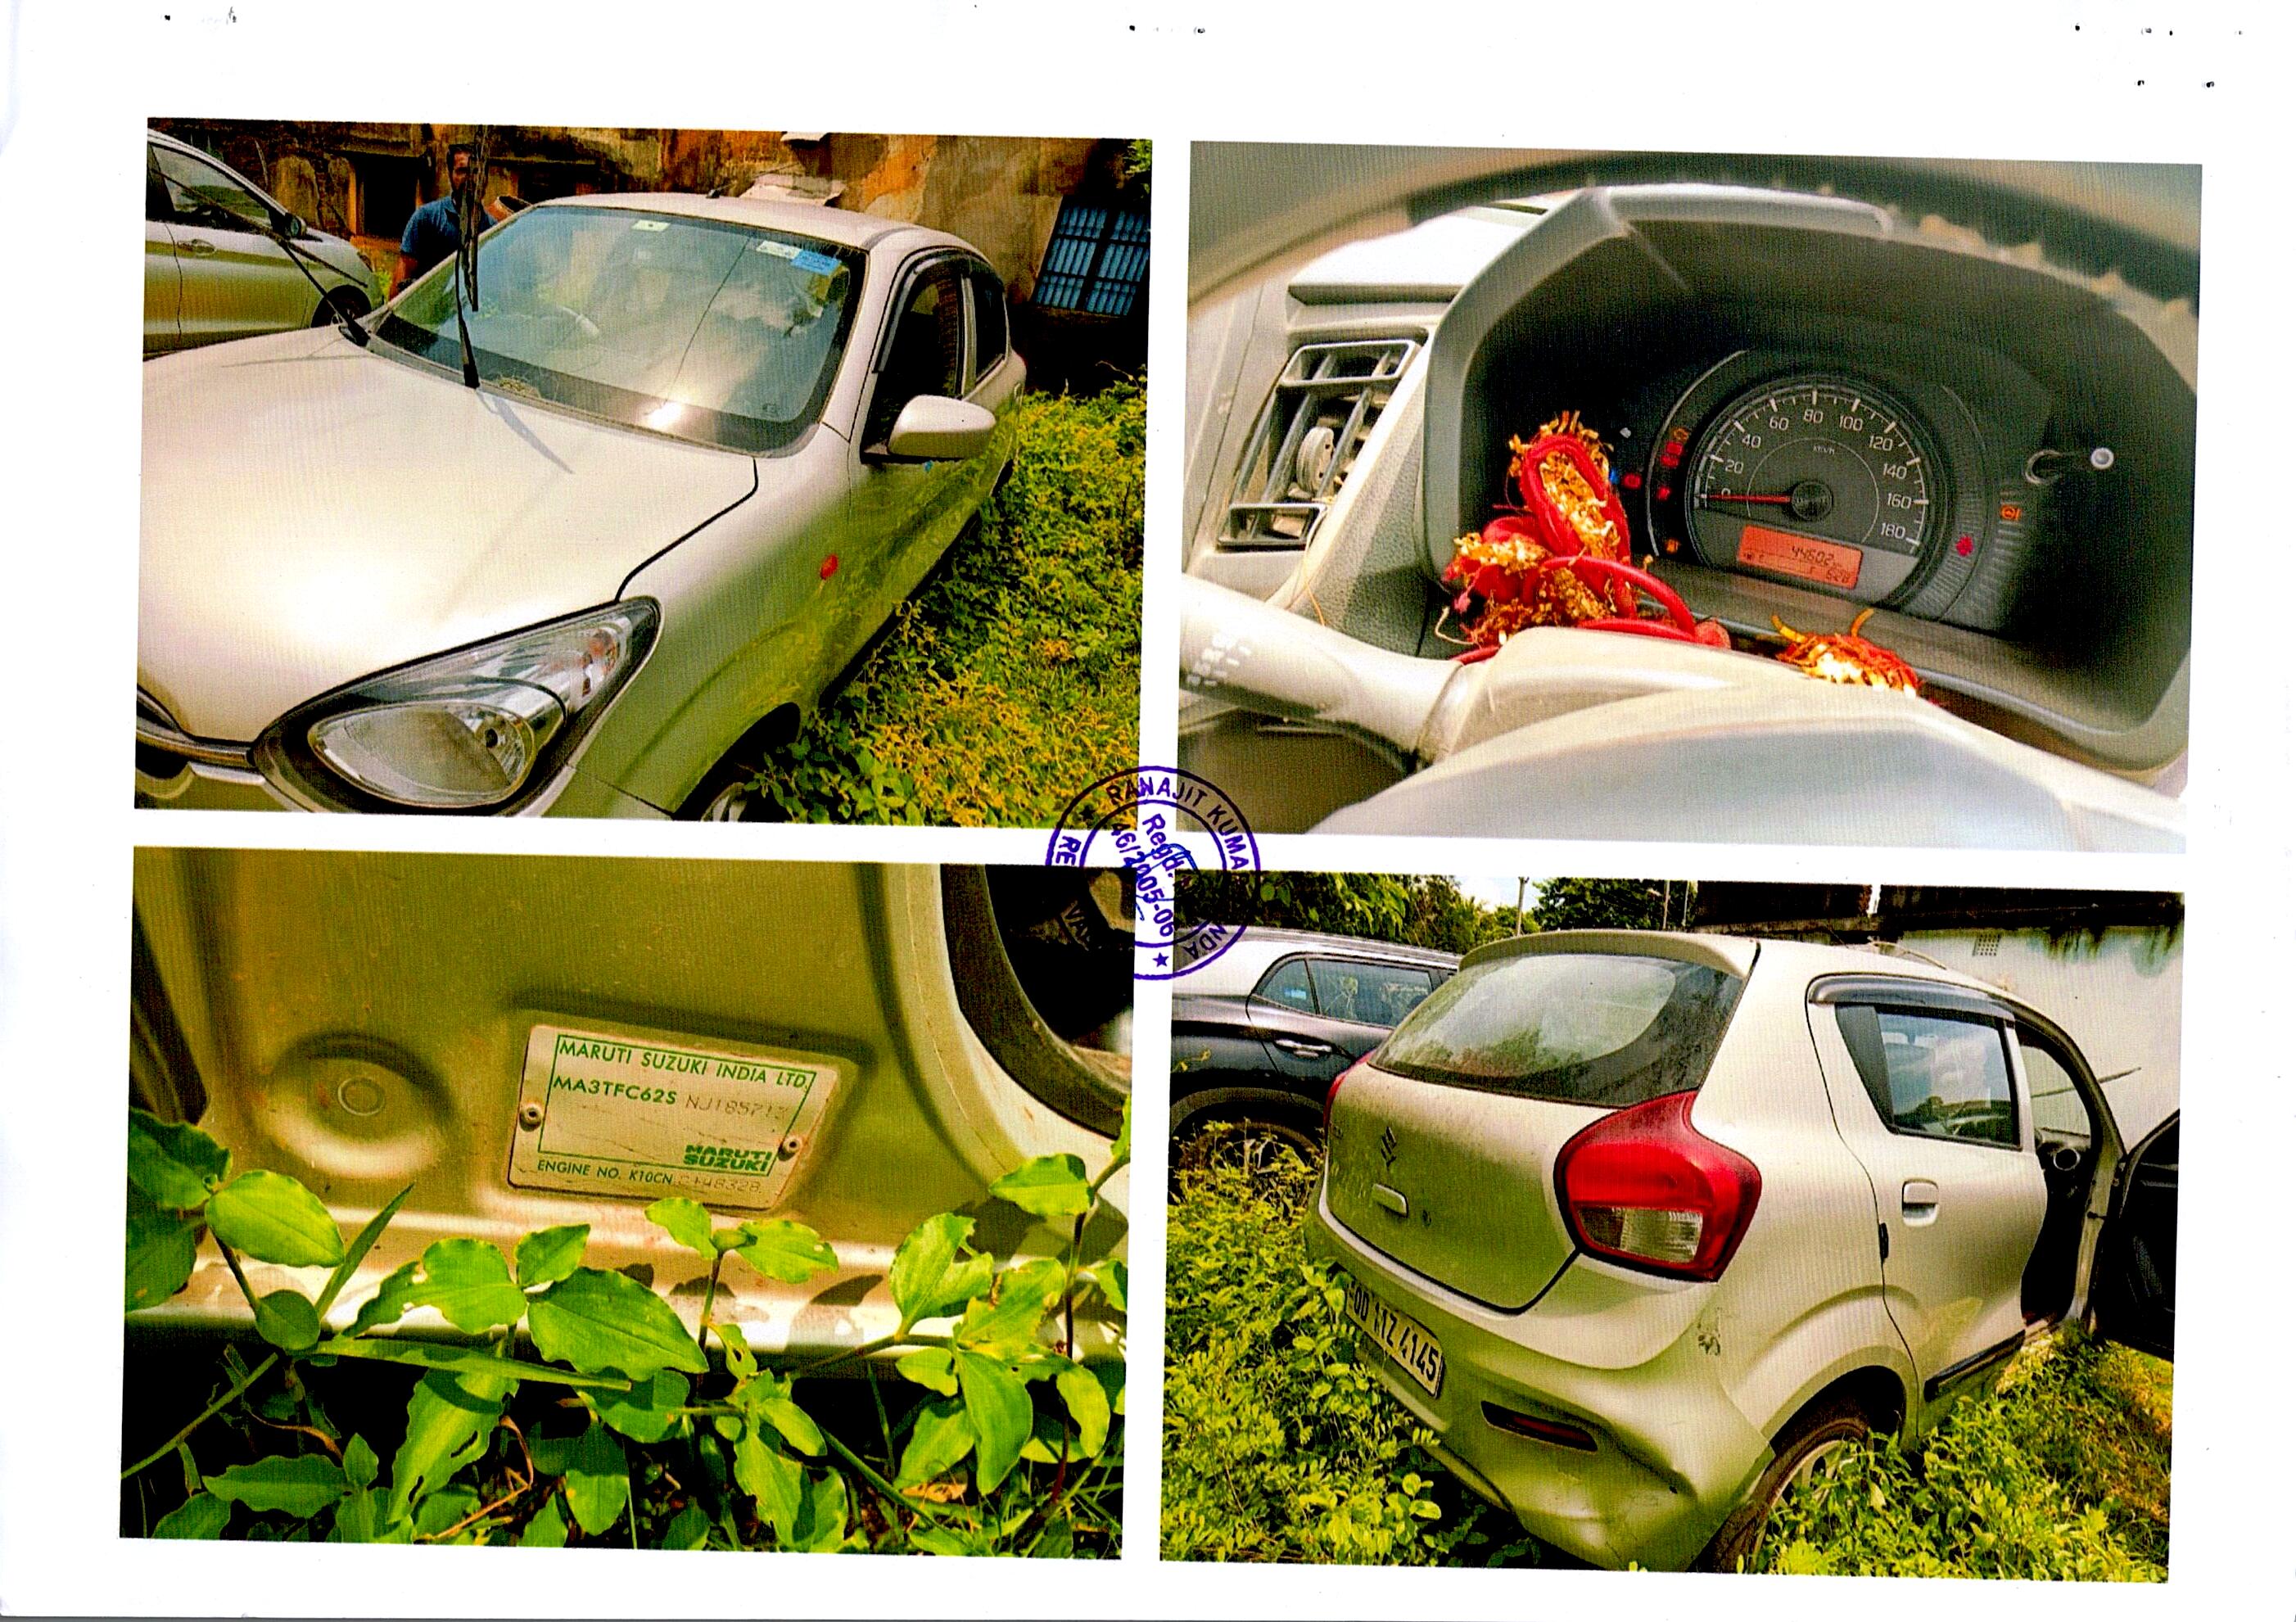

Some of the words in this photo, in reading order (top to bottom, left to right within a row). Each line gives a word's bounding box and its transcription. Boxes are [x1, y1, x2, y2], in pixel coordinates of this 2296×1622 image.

[1769, 417, 1789, 431] 60
[1803, 409, 1824, 424] 80
[1839, 415, 1864, 432] 100
[1742, 435, 1761, 450] 40
[1869, 435, 1893, 451] 120
[1725, 459, 1744, 475] 20
[1883, 463, 1907, 480] 140
[1887, 494, 1912, 509] 160
[1882, 522, 1906, 540] 180
[559, 1039, 631, 1064] MARUTI
[641, 1051, 709, 1075] SUZUKI
[716, 1063, 766, 1083] INDIA
[553, 1075, 678, 1105] MA3TFC62S
[685, 1144, 772, 1161] MARUTI
[683, 1154, 769, 1172] SUZUKI
[538, 1159, 591, 1177] ENGINE
[597, 1166, 621, 1180] NO.
[629, 1170, 672, 1186] K10CN
[1399, 1326, 1440, 1382] 4145
